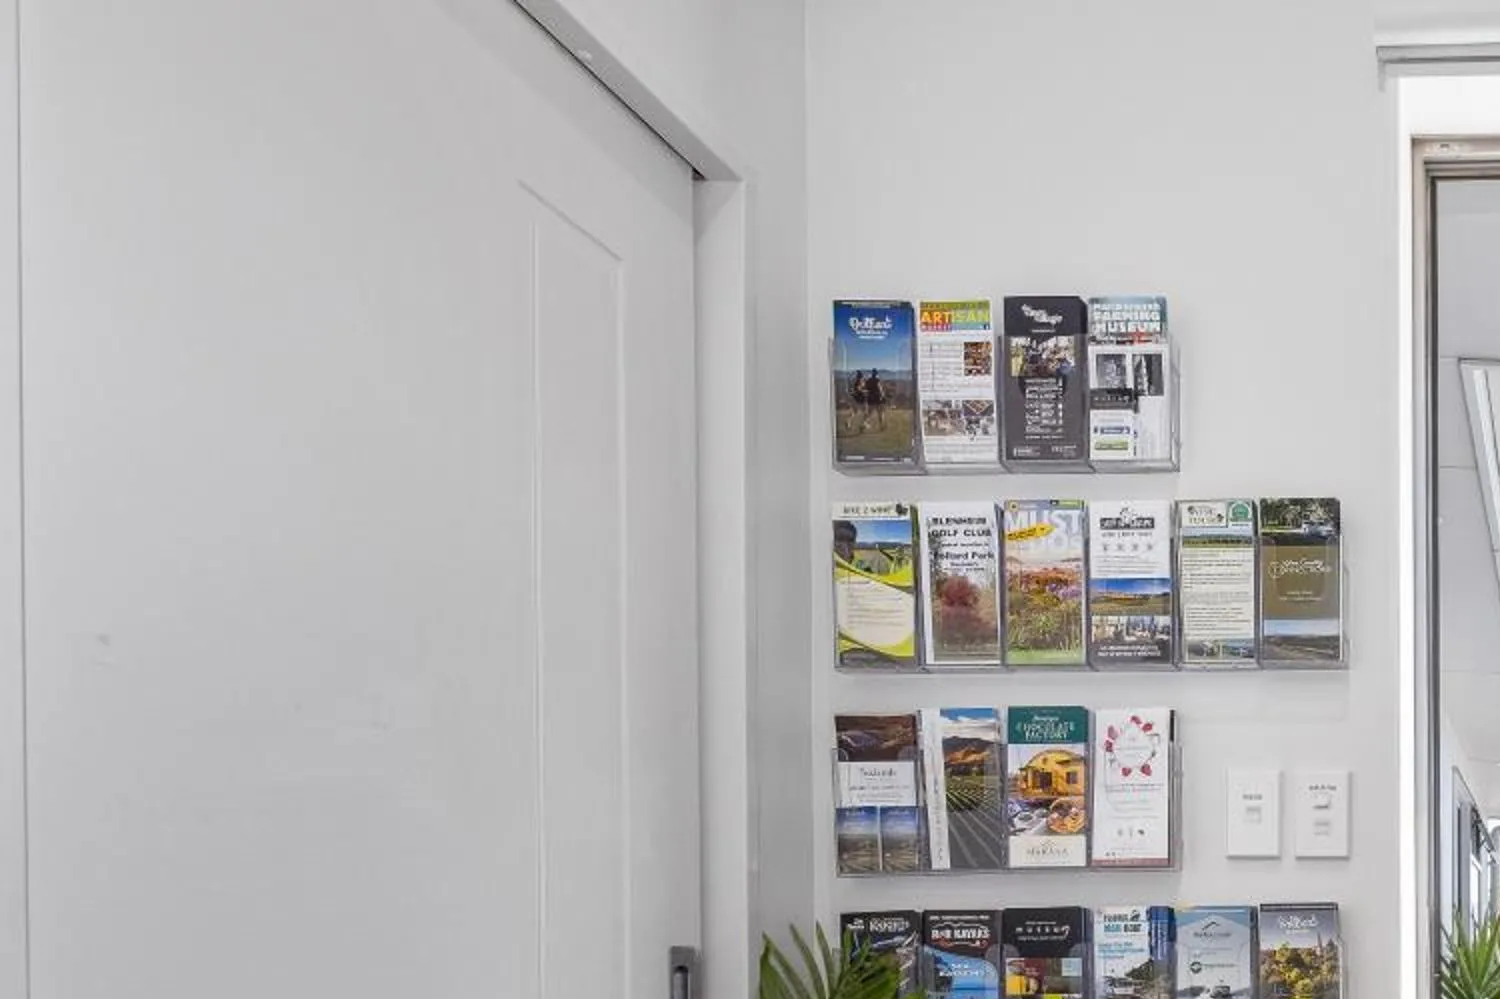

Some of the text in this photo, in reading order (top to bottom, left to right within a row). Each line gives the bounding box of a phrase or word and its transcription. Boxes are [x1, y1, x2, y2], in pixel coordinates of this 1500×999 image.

[921, 311, 989, 323] ARTISAN
[1093, 311, 1161, 321] FARMING
[1095, 321, 1161, 333] MUSEUM
[931, 517, 987, 525] BLENHEIM
[1006, 510, 1083, 532] MUST
[931, 529, 992, 537] GOLF CLUB
[971, 551, 995, 560] Park
